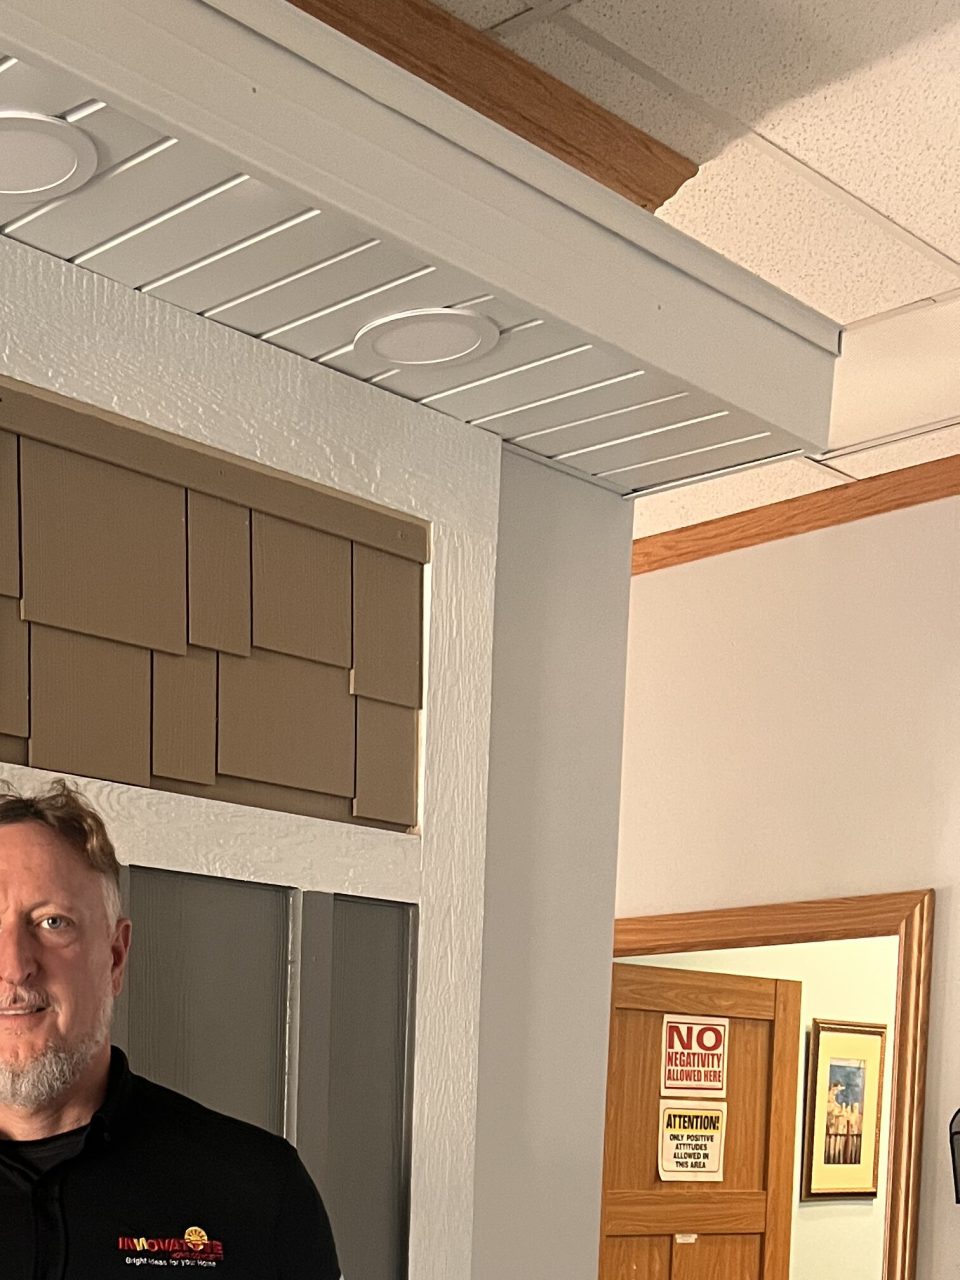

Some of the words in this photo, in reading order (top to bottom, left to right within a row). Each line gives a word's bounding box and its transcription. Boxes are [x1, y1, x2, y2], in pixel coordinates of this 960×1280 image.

[667, 1025, 723, 1051] NO
[667, 1051, 722, 1068] NEGATIVITY
[667, 1069, 701, 1082] ALLOWED
[704, 1070, 722, 1083] HERE
[666, 1114, 720, 1130] ATTENTION!
[669, 1134, 685, 1142] ONLY
[686, 1134, 714, 1143] POSITIVE
[675, 1143, 708, 1151] ATTITUDES
[673, 1152, 701, 1160] ALLOWED
[702, 1152, 709, 1160] IN
[690, 1161, 706, 1169] AREA
